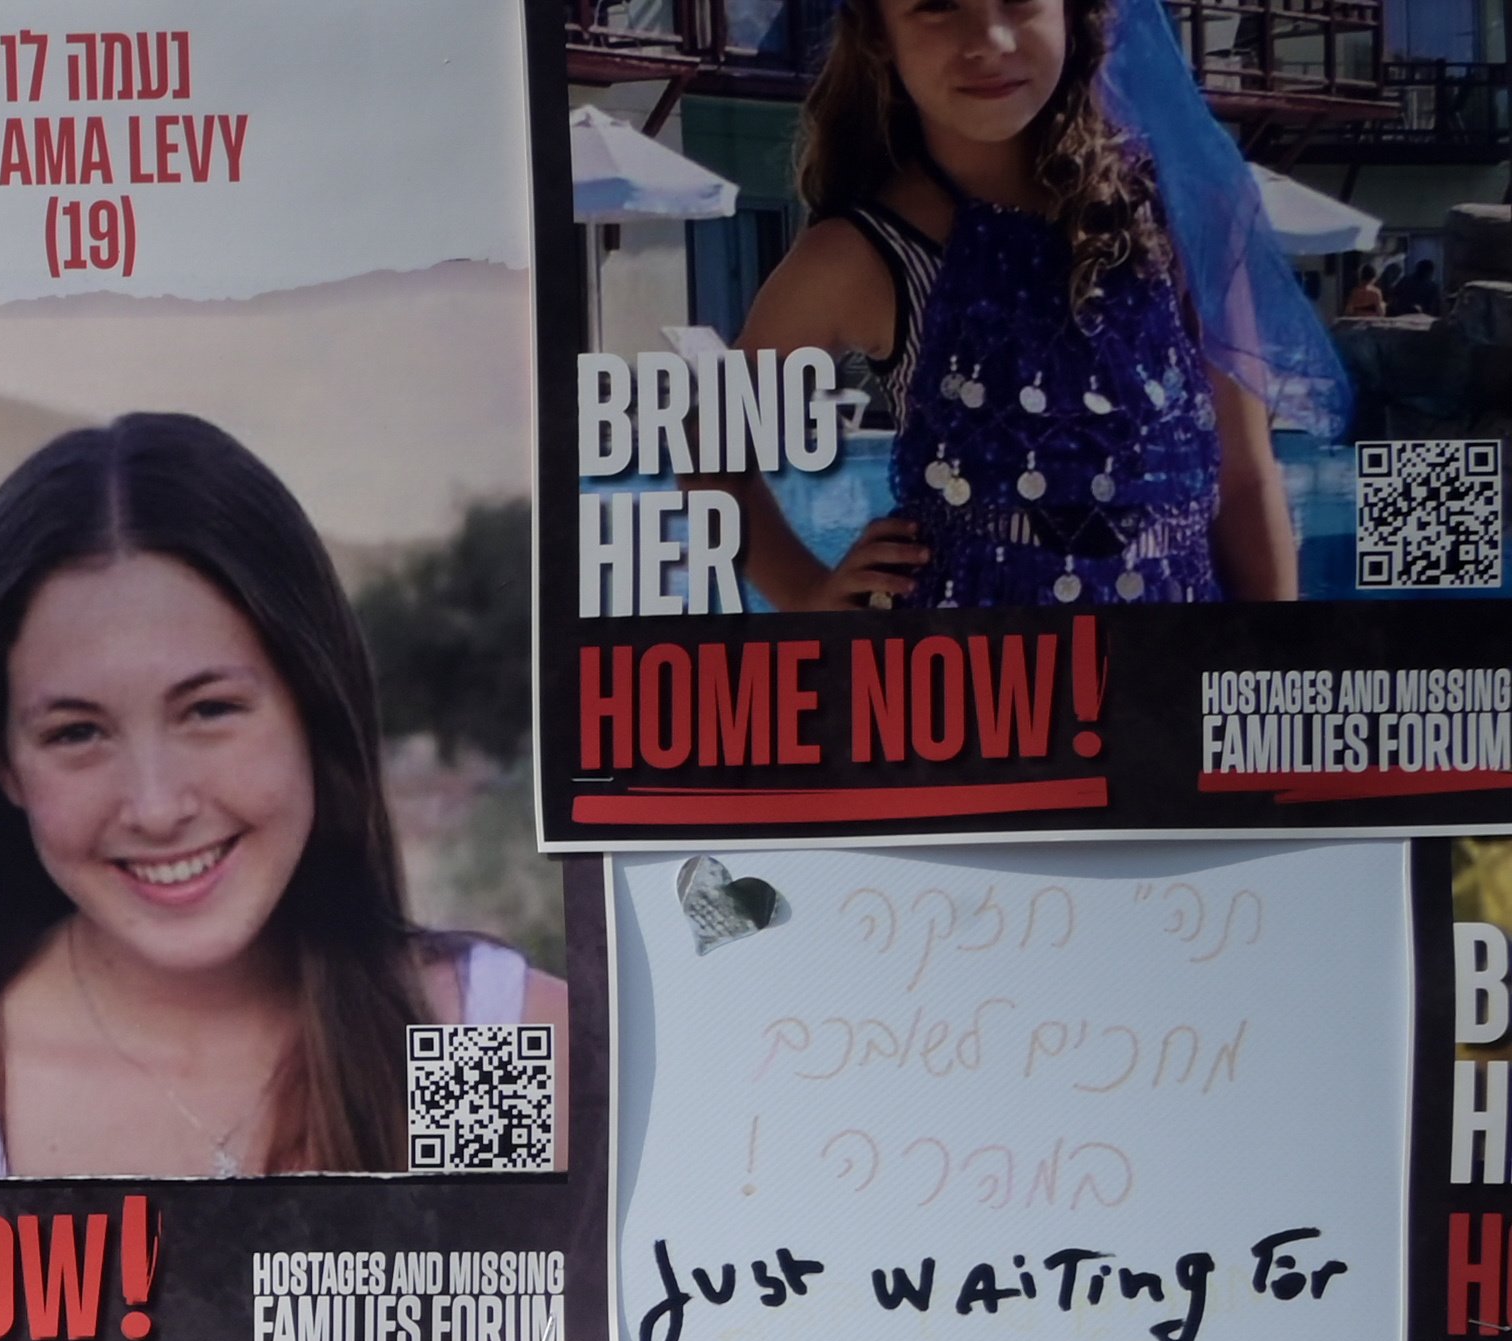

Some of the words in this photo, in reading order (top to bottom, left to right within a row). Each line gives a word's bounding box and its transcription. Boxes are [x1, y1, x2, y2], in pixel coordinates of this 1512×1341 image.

[68, 32, 191, 100] נעמה
[131, 115, 248, 182] LEVY
[47, 196, 136, 277] (19)
[577, 347, 838, 476] BRING
[579, 487, 742, 618] HER
[580, 640, 822, 769] HOME
[852, 615, 1102, 762] NOW!
